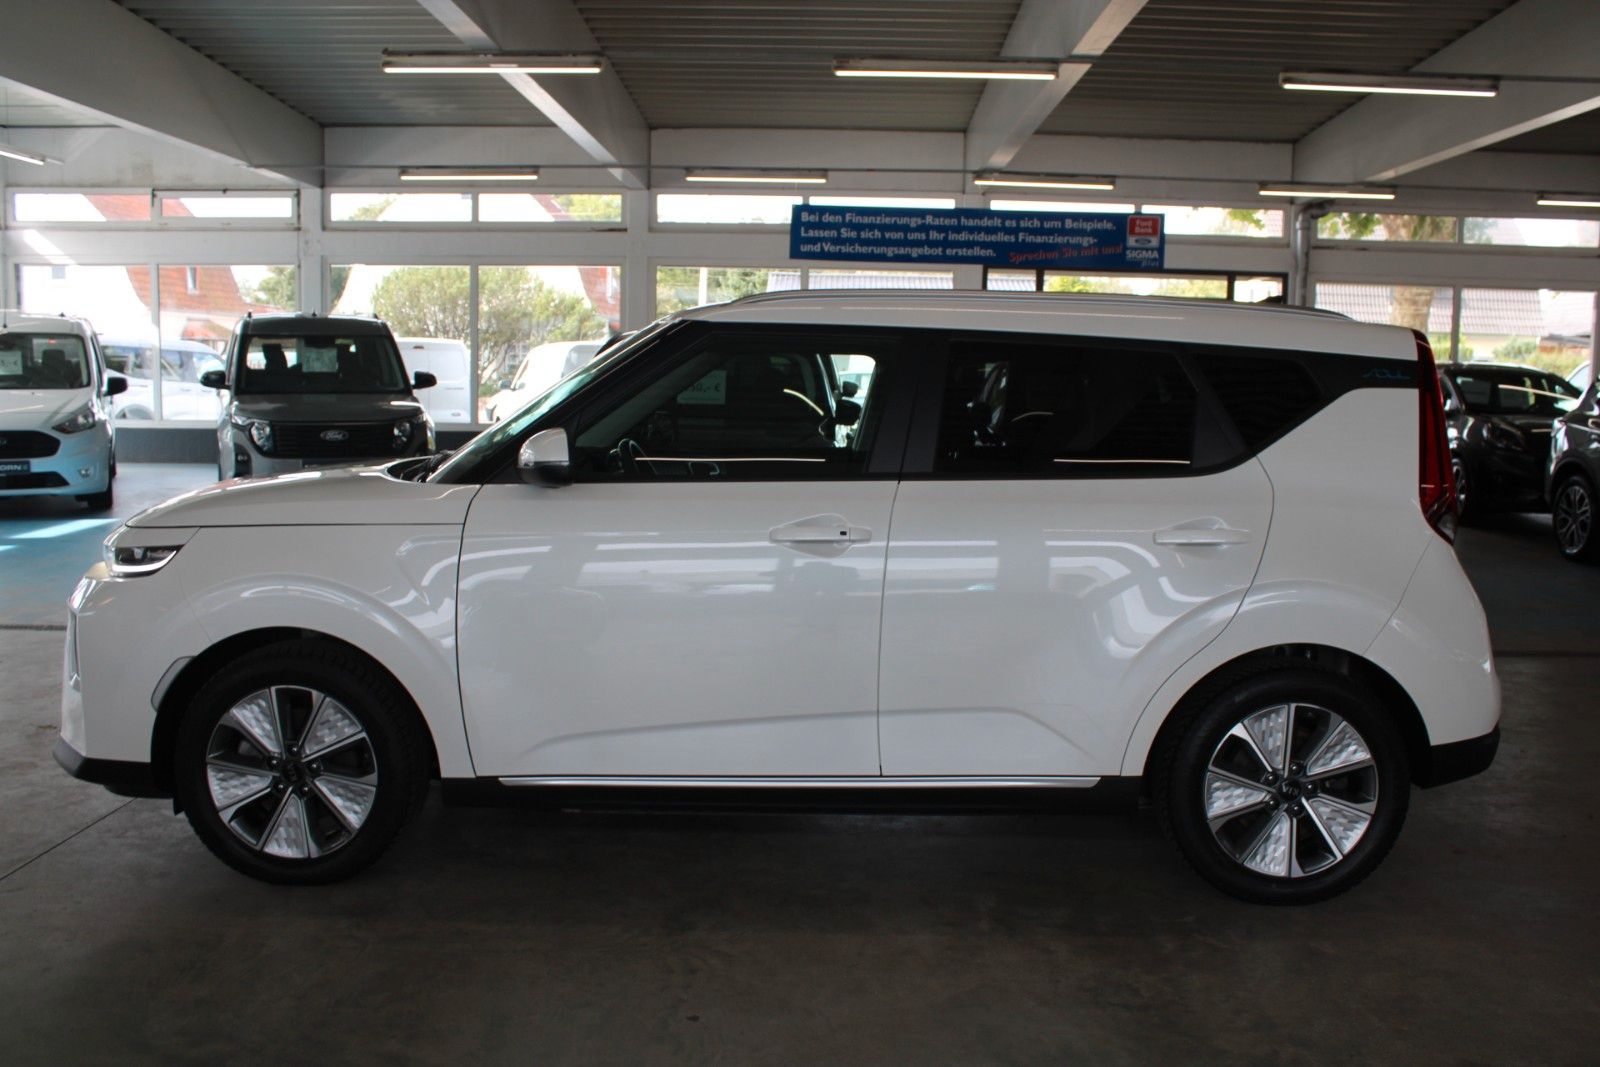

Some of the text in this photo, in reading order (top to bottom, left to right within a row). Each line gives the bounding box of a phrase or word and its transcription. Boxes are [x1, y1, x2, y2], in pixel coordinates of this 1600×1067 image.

[801, 212, 1116, 231] Bei den Finanzierungs-Raten handelt es sich um Beispiele.
[800, 227, 1098, 247] Lassen Sie sich von uns Ihr individuelles Finanzierungs-
[800, 242, 996, 258] und Versicherungsangebot erstellen.
[1008, 250, 1058, 264] Sprechen
